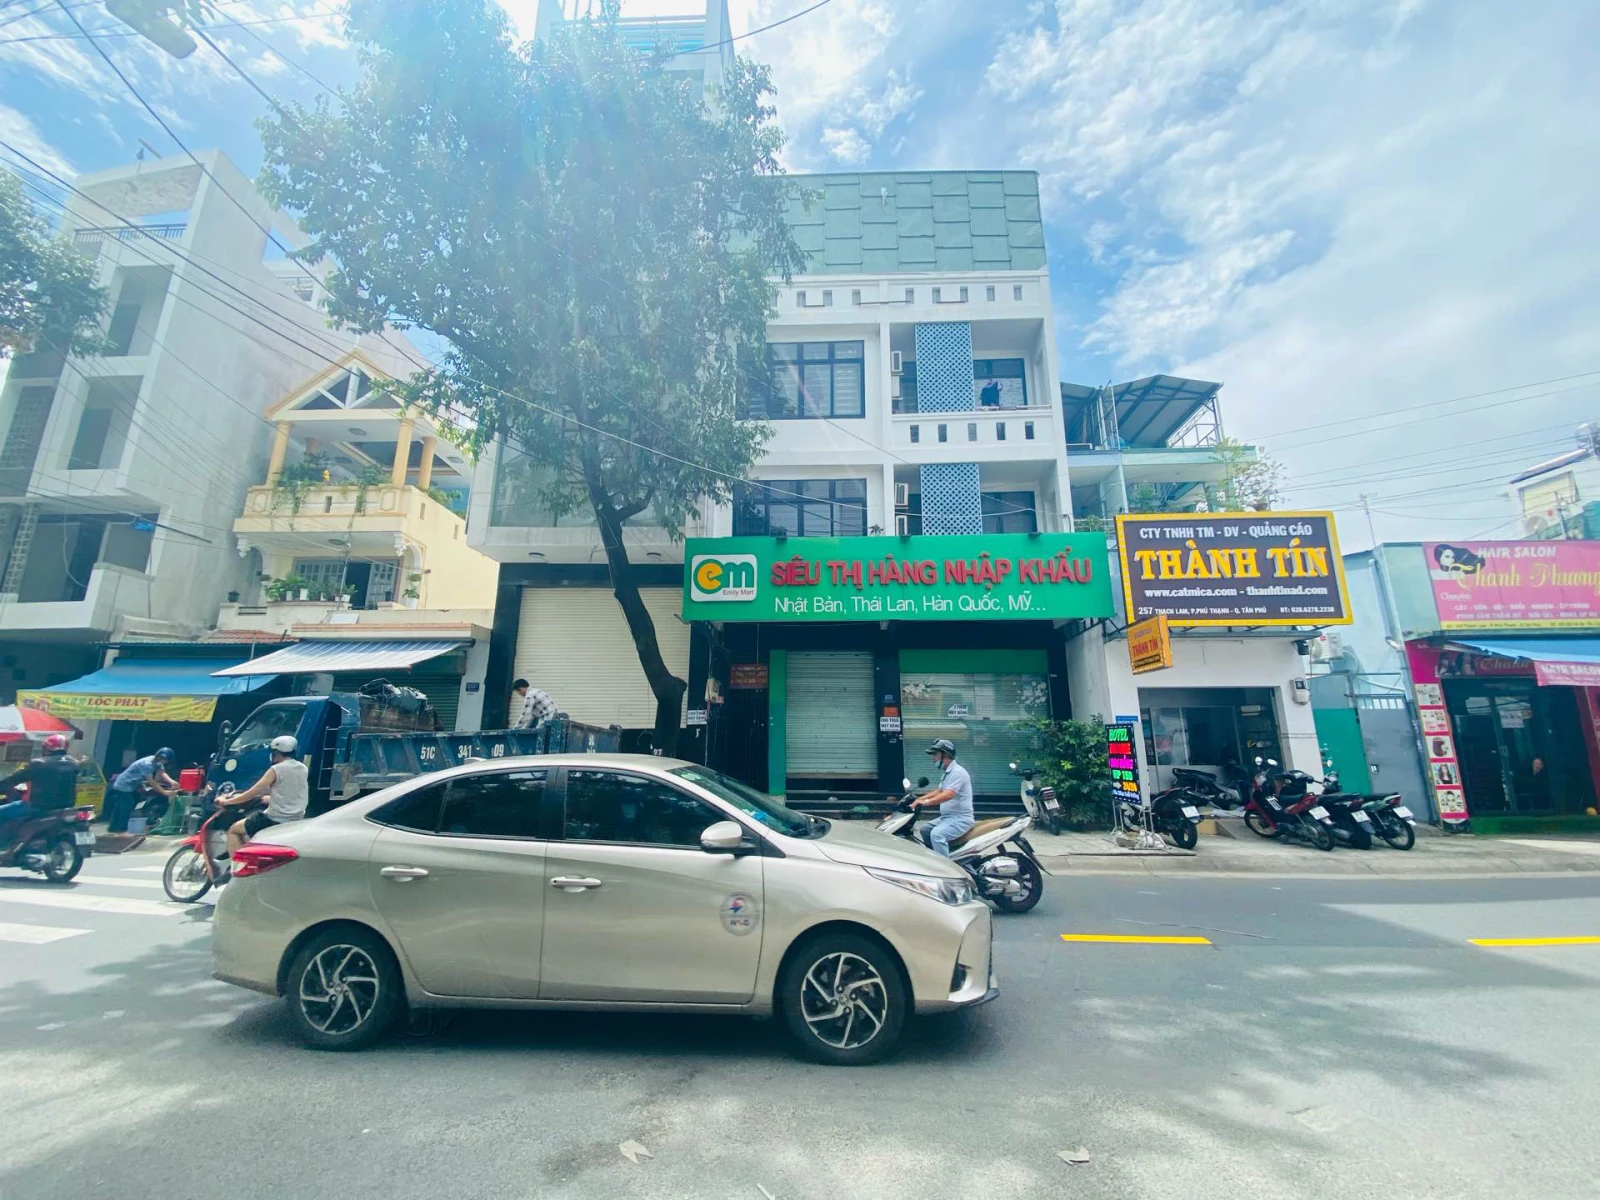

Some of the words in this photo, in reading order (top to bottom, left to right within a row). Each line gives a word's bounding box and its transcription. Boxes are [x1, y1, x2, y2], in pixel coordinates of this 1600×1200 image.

[1139, 527, 1161, 539] CTY
[1163, 526, 1194, 539] TNHH
[1198, 527, 1214, 538] TM
[1224, 526, 1240, 537] DV
[1249, 520, 1288, 537] QUẢNG
[1288, 521, 1313, 536] CÁO
[1134, 539, 1261, 580] THÀNH
[1266, 537, 1329, 578] TÍN
[1477, 547, 1512, 559] HAIR
[1513, 546, 1557, 558] SALON
[771, 554, 821, 586] SIÊU
[826, 559, 863, 591] THỊ
[867, 553, 937, 586] HÀNG
[943, 551, 1012, 591] NHẬP
[1019, 545, 1093, 584] KHẨU
[1449, 562, 1521, 591] Thanh
[722, 591, 741, 601] Emily
[741, 590, 756, 600] Mart
[1144, 587, 1237, 598] www.catmica.com
[774, 597, 808, 616] Nhật
[813, 595, 847, 614] Bản,
[851, 596, 882, 613] Thái
[887, 596, 919, 613] Lan,
[922, 594, 953, 612] Hàn
[958, 592, 1005, 613] Quốc,
[1138, 607, 1153, 615] 257
[420, 745, 436, 760] 51C
[457, 744, 472, 759] 341
